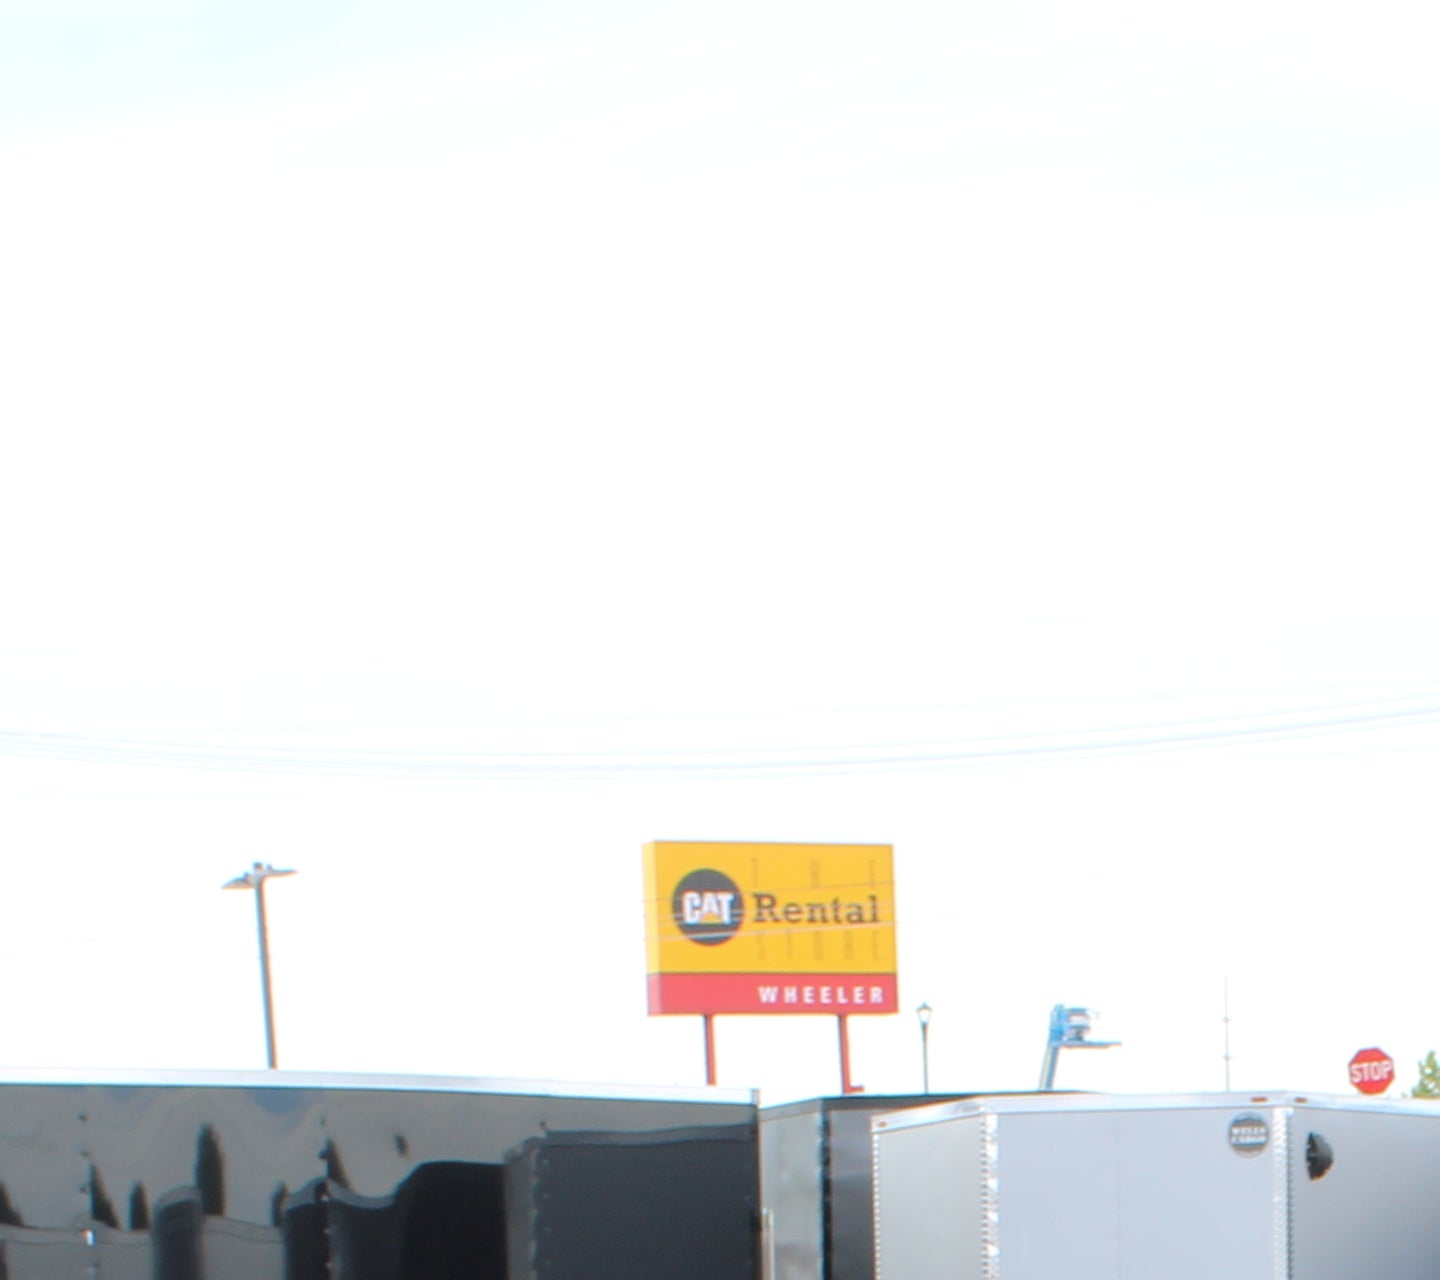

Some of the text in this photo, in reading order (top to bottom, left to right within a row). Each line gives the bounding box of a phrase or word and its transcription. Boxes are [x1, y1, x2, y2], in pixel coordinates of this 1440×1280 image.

[682, 891, 881, 924] CAT Rental
[758, 986, 884, 1004] WHEELER
[1351, 1060, 1393, 1083] STOP
